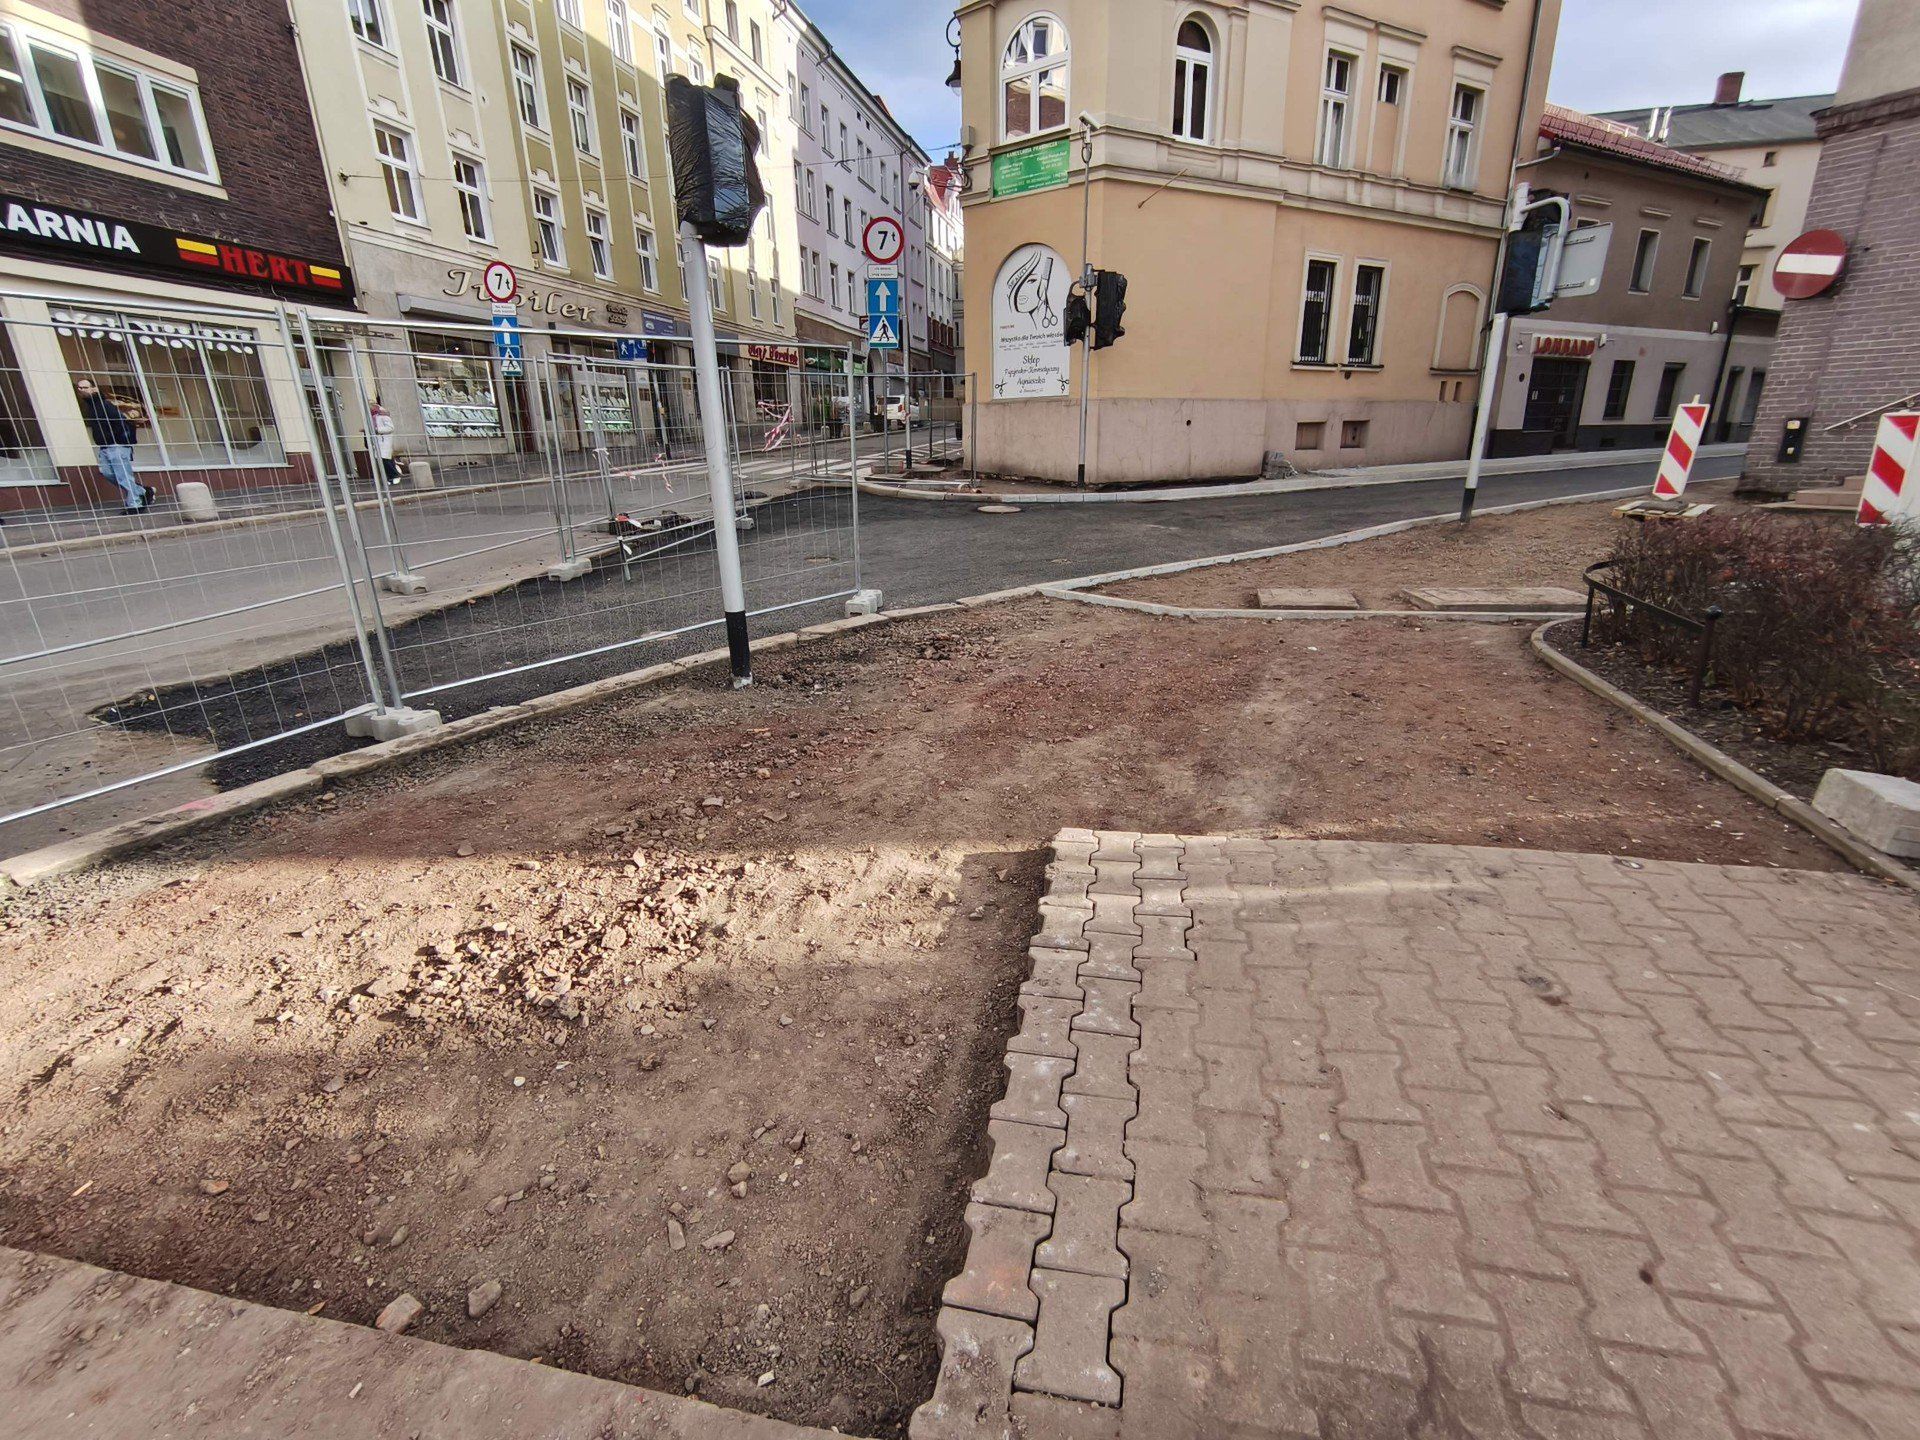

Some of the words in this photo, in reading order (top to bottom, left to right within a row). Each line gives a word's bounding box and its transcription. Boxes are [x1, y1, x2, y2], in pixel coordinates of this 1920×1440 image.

[0, 203, 141, 254] ARNIA
[218, 244, 309, 285] HERT
[1022, 354, 1041, 367] Sklep
[1534, 336, 1596, 356] LOMBARD
